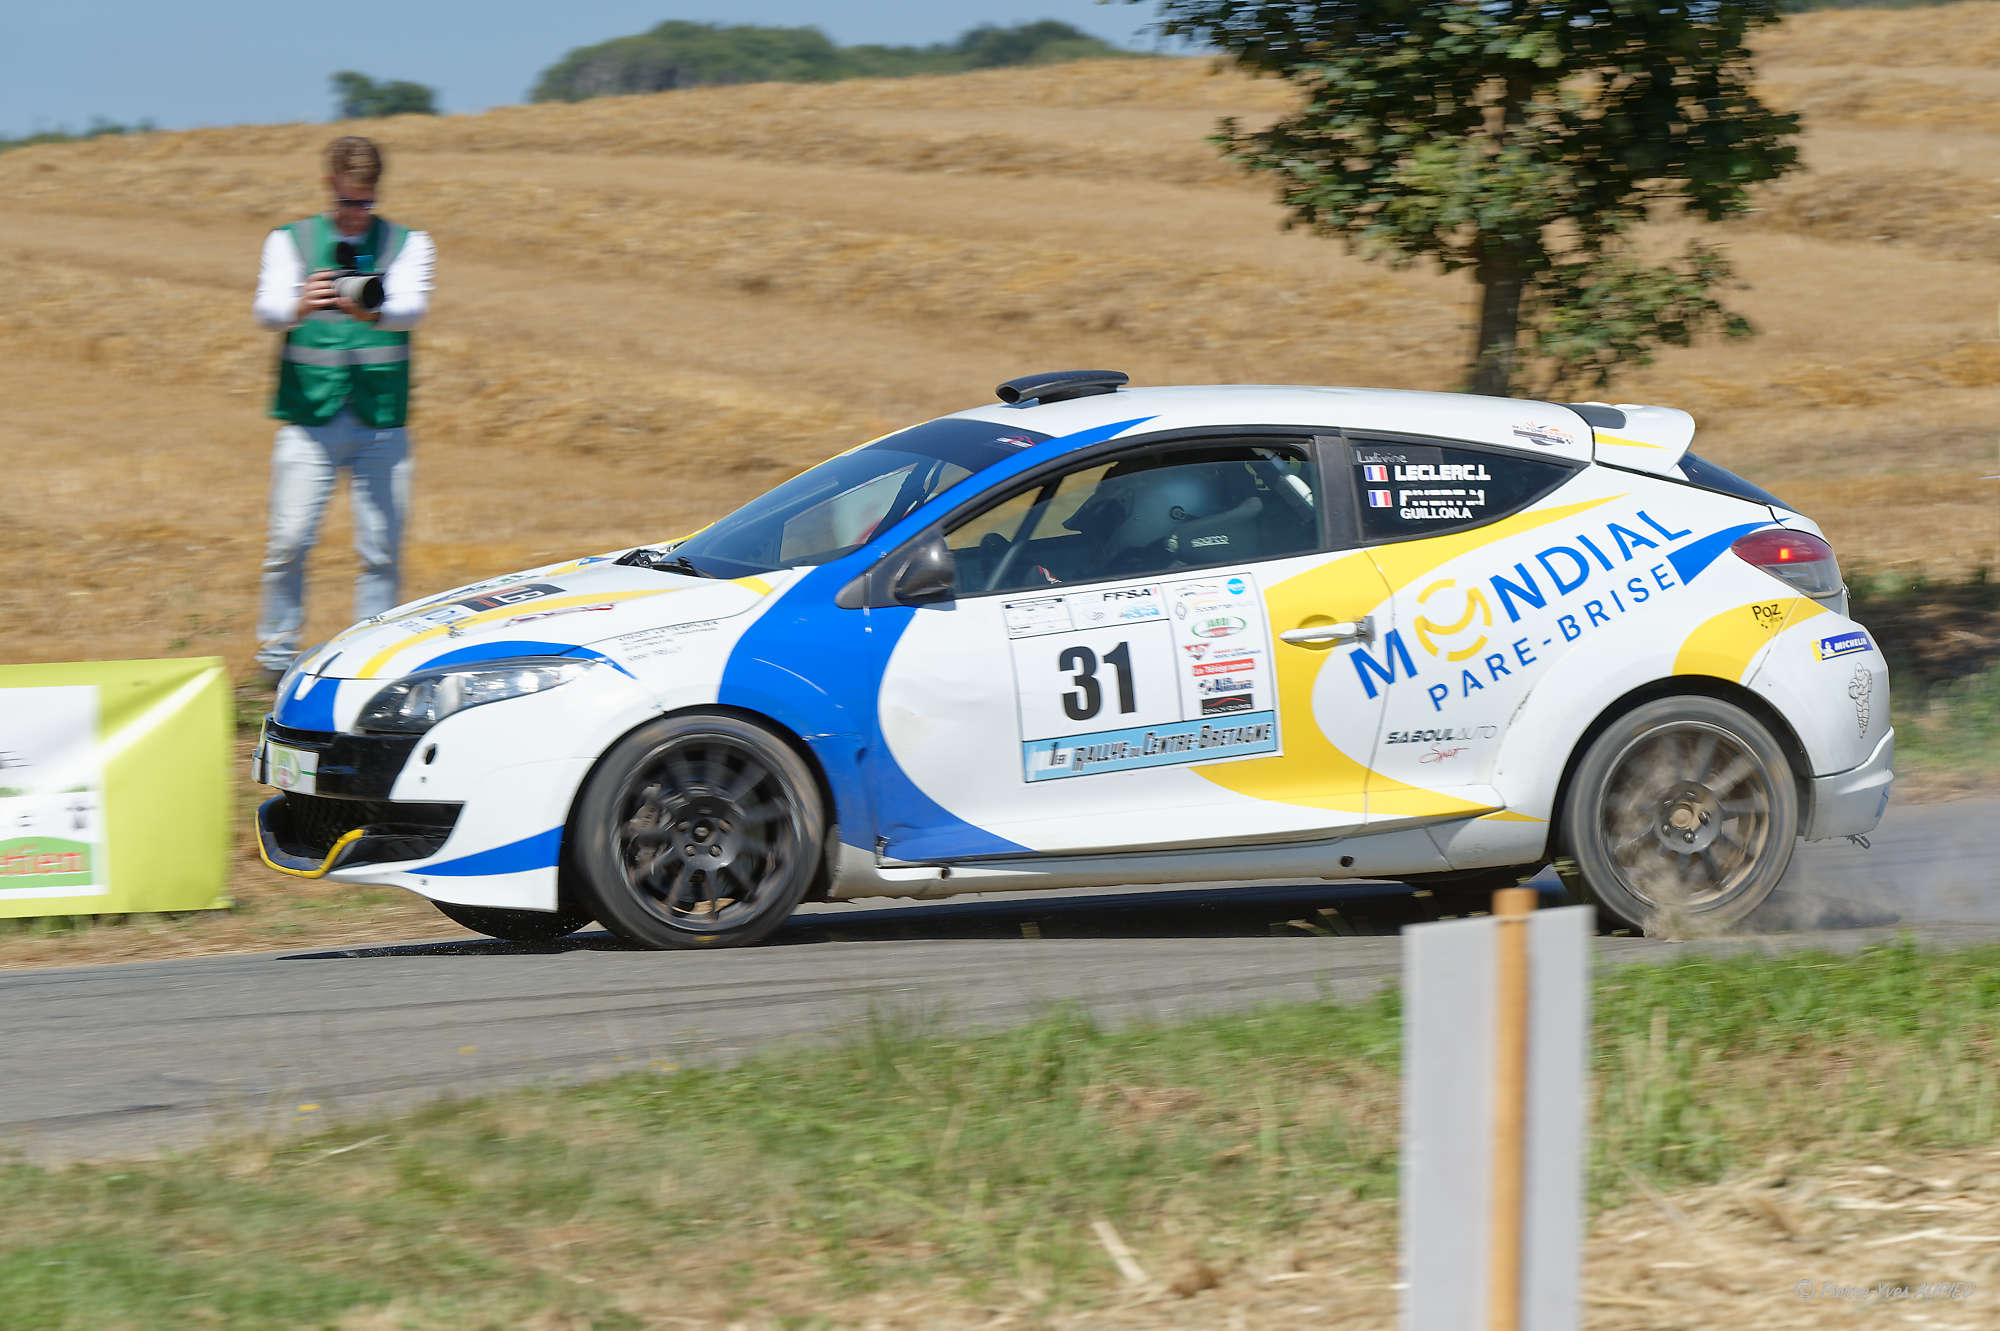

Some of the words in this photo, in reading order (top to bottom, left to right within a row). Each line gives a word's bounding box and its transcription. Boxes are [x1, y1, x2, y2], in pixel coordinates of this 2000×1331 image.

[1103, 588, 1152, 602] FFSA
[1349, 510, 1693, 700] MONDIAL
[1427, 562, 1676, 712] PARE-BRISE
[1833, 636, 1868, 651] MICHELIN
[1059, 641, 1136, 721] 31
